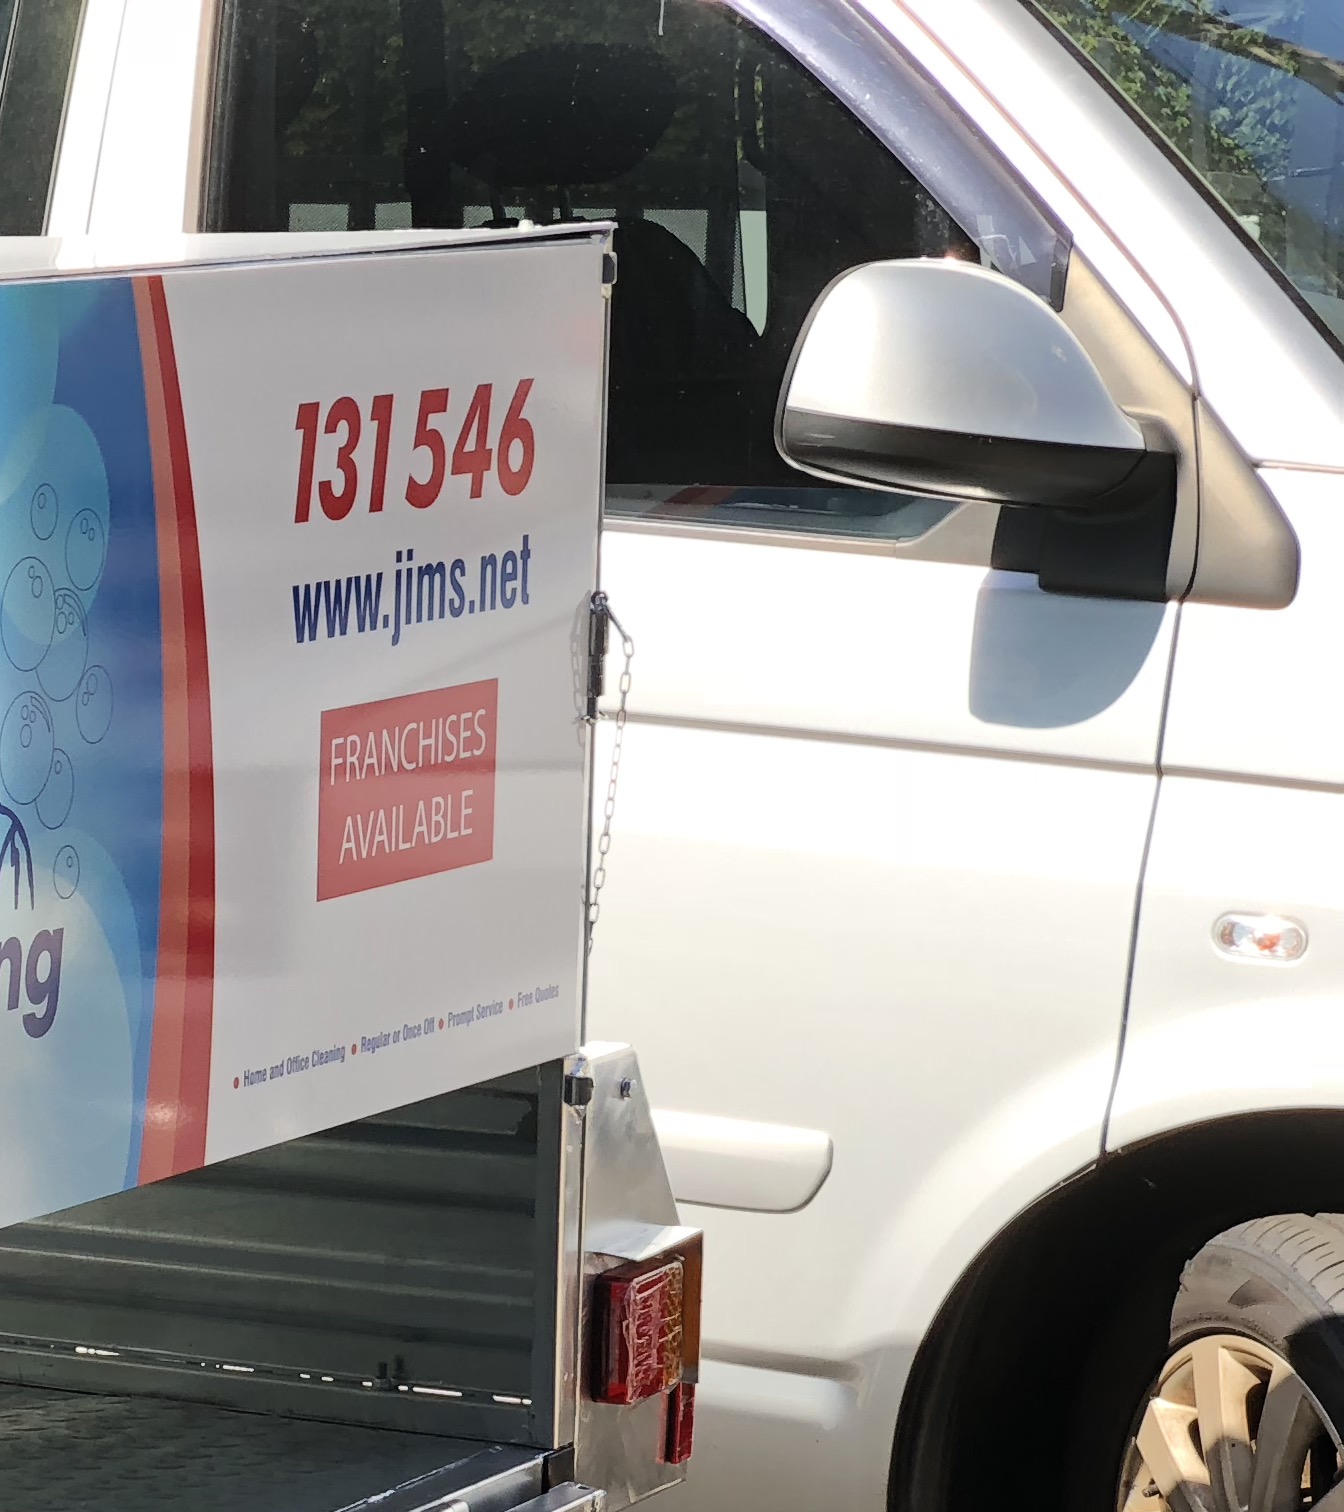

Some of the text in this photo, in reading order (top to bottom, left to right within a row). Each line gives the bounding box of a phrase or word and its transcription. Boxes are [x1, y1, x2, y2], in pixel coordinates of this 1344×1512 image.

[294, 378, 535, 523] 131 546
[292, 534, 531, 646] www.jims.net
[330, 708, 486, 786] FRANCHISES
[339, 790, 474, 865] AVAILABLE
[360, 1017, 435, 1054] Regular or Once Off
[448, 999, 504, 1029] Prompt Service
[243, 1044, 346, 1088] Home and Office Cleaning
